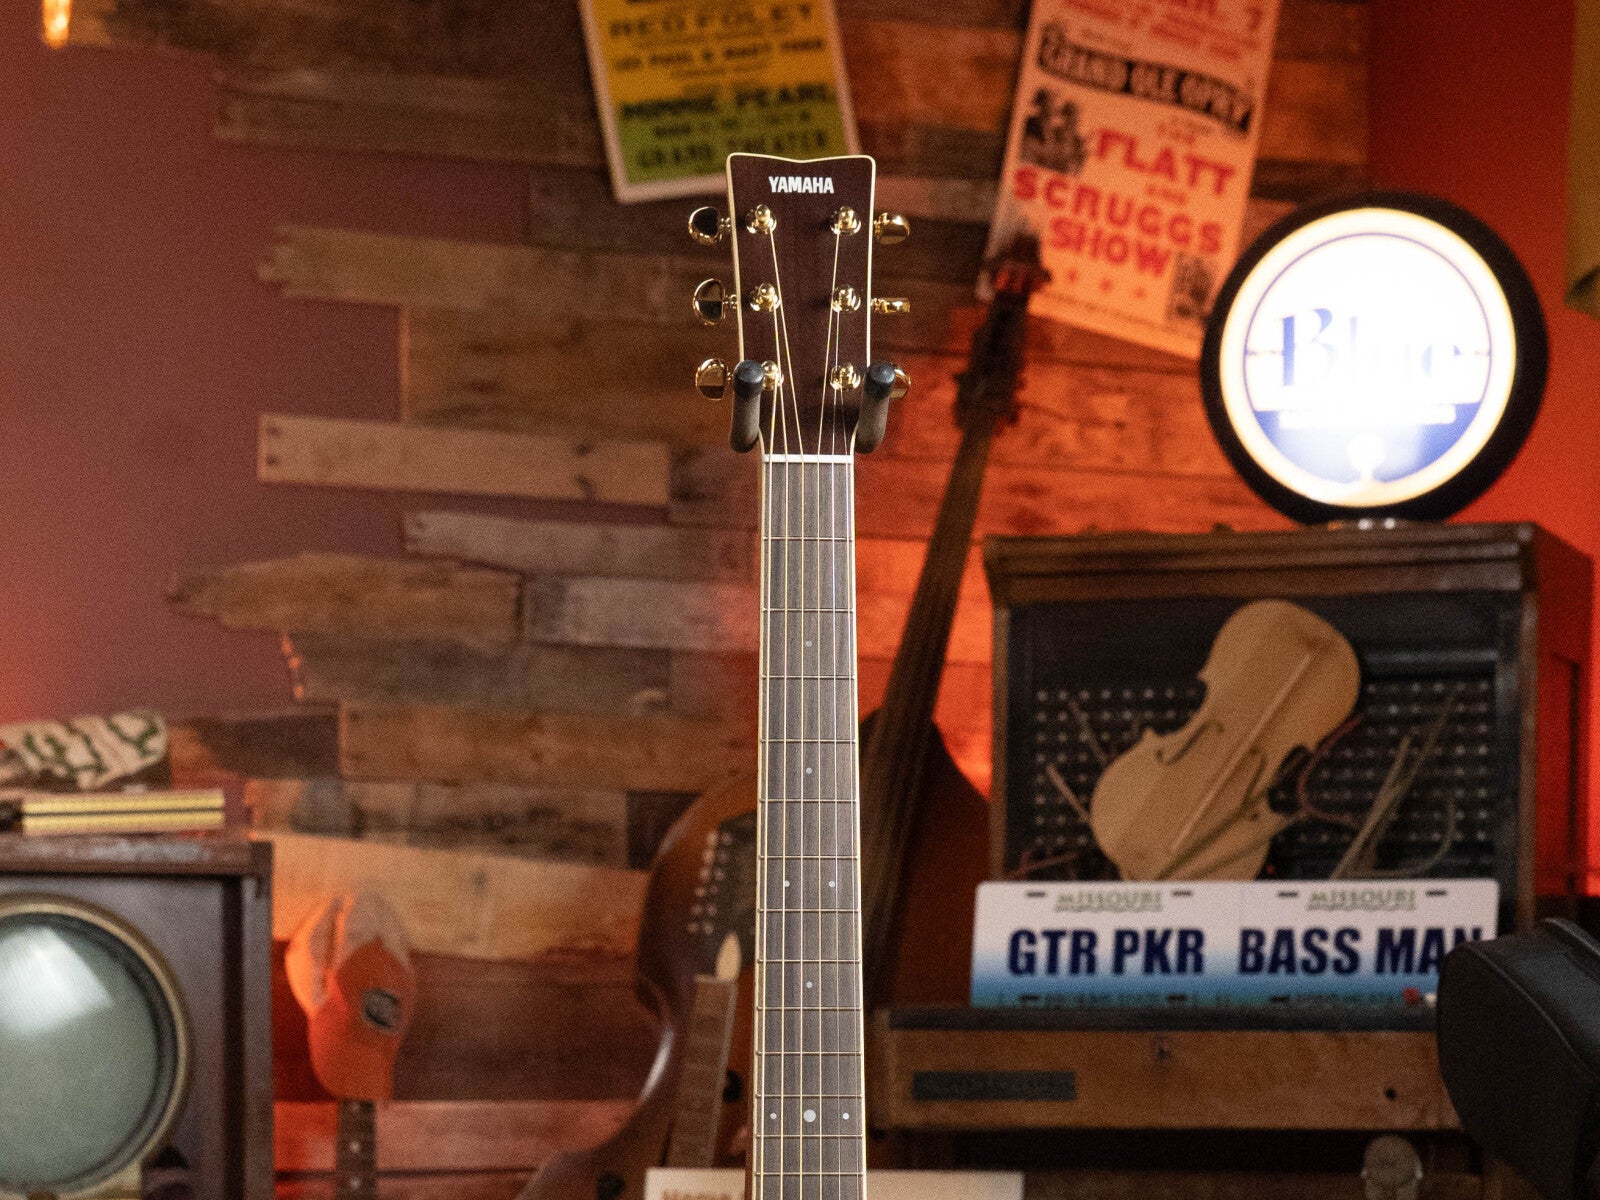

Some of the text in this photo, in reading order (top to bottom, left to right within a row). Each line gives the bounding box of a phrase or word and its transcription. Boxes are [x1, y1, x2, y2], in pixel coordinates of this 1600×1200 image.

[768, 176, 835, 194] YAMAHA
[1096, 128, 1236, 197] FLATT
[1013, 166, 1225, 256] SCRUGGS
[1049, 216, 1171, 278] SHOW
[1008, 928, 1205, 977] GTR PKR
[1238, 927, 1362, 977] BASS
